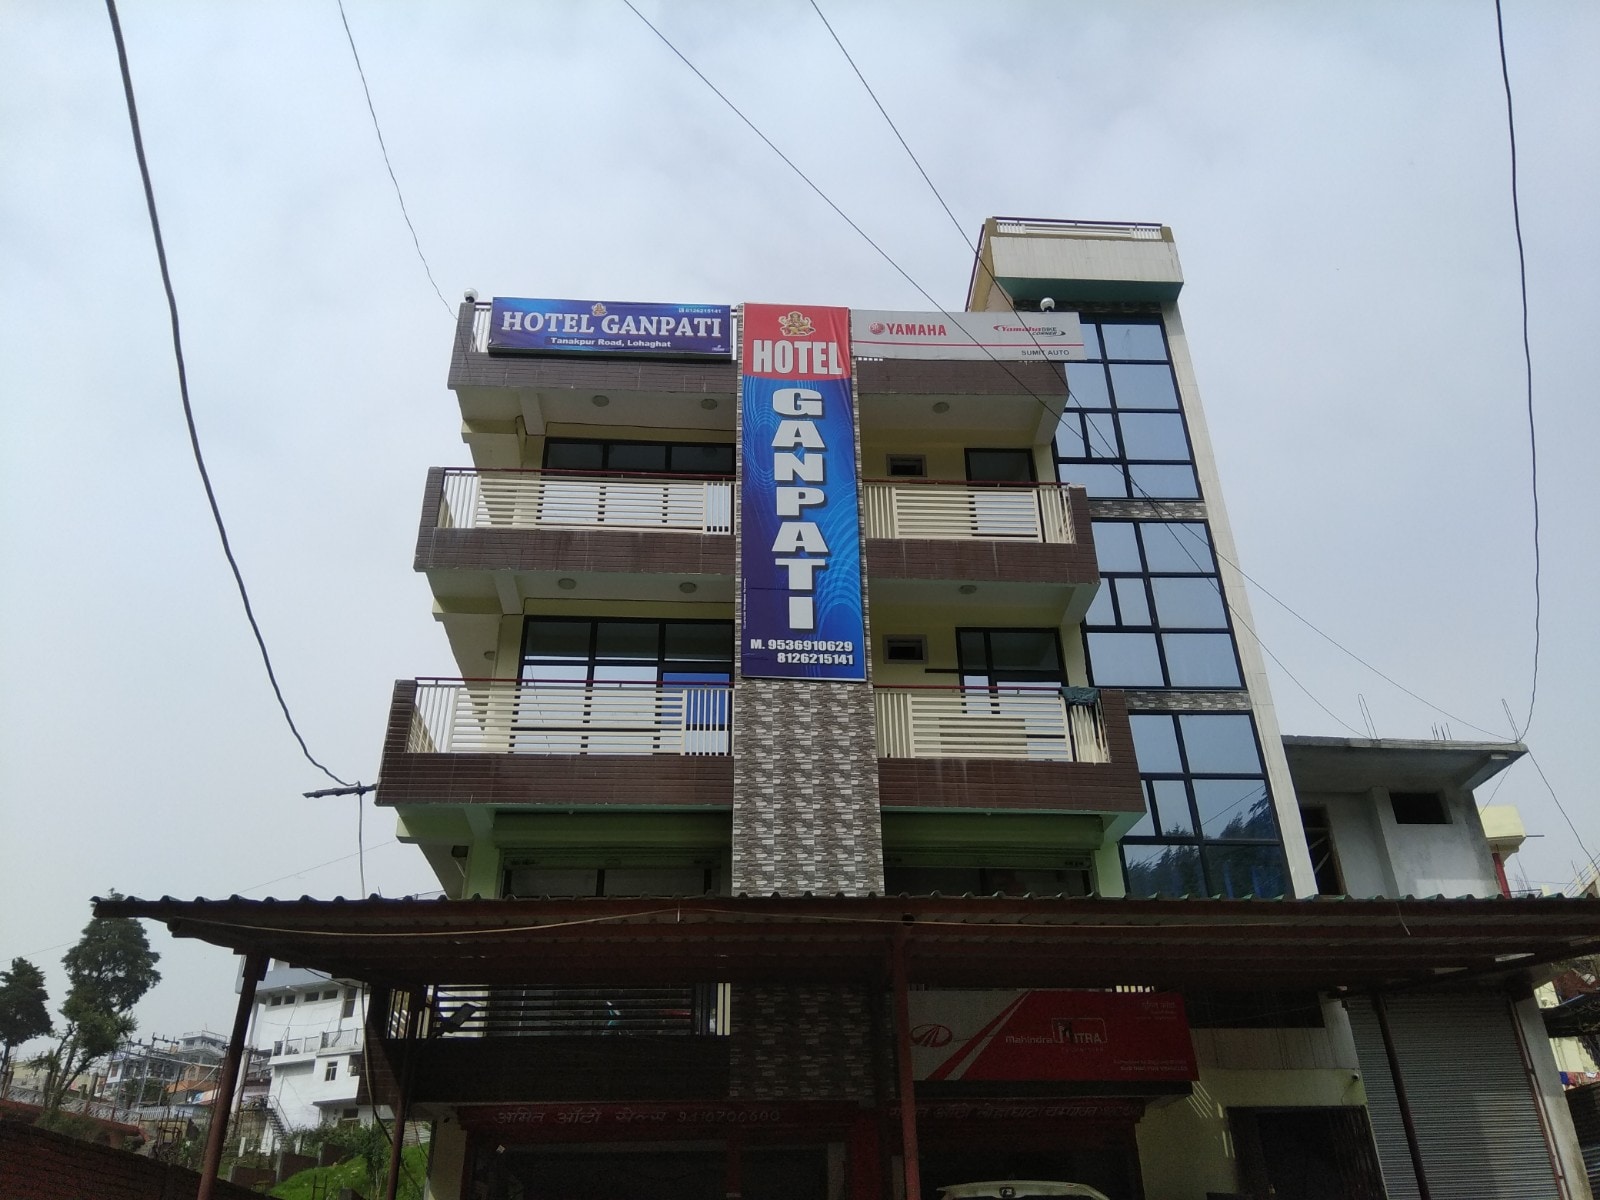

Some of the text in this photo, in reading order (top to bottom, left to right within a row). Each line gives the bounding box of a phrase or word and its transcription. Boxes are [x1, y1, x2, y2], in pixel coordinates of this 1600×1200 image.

[501, 311, 722, 337] HOTEL GANPATI
[886, 323, 947, 336] YAMAHA
[551, 337, 671, 349] Tanakpur Road, Lohaghat
[753, 339, 843, 375] HOTEL
[771, 388, 829, 629] GANPATI
[750, 639, 853, 652] M. 9536910629
[777, 652, 854, 665] 8126215141
[1005, 1035, 1053, 1044] Mahindra
